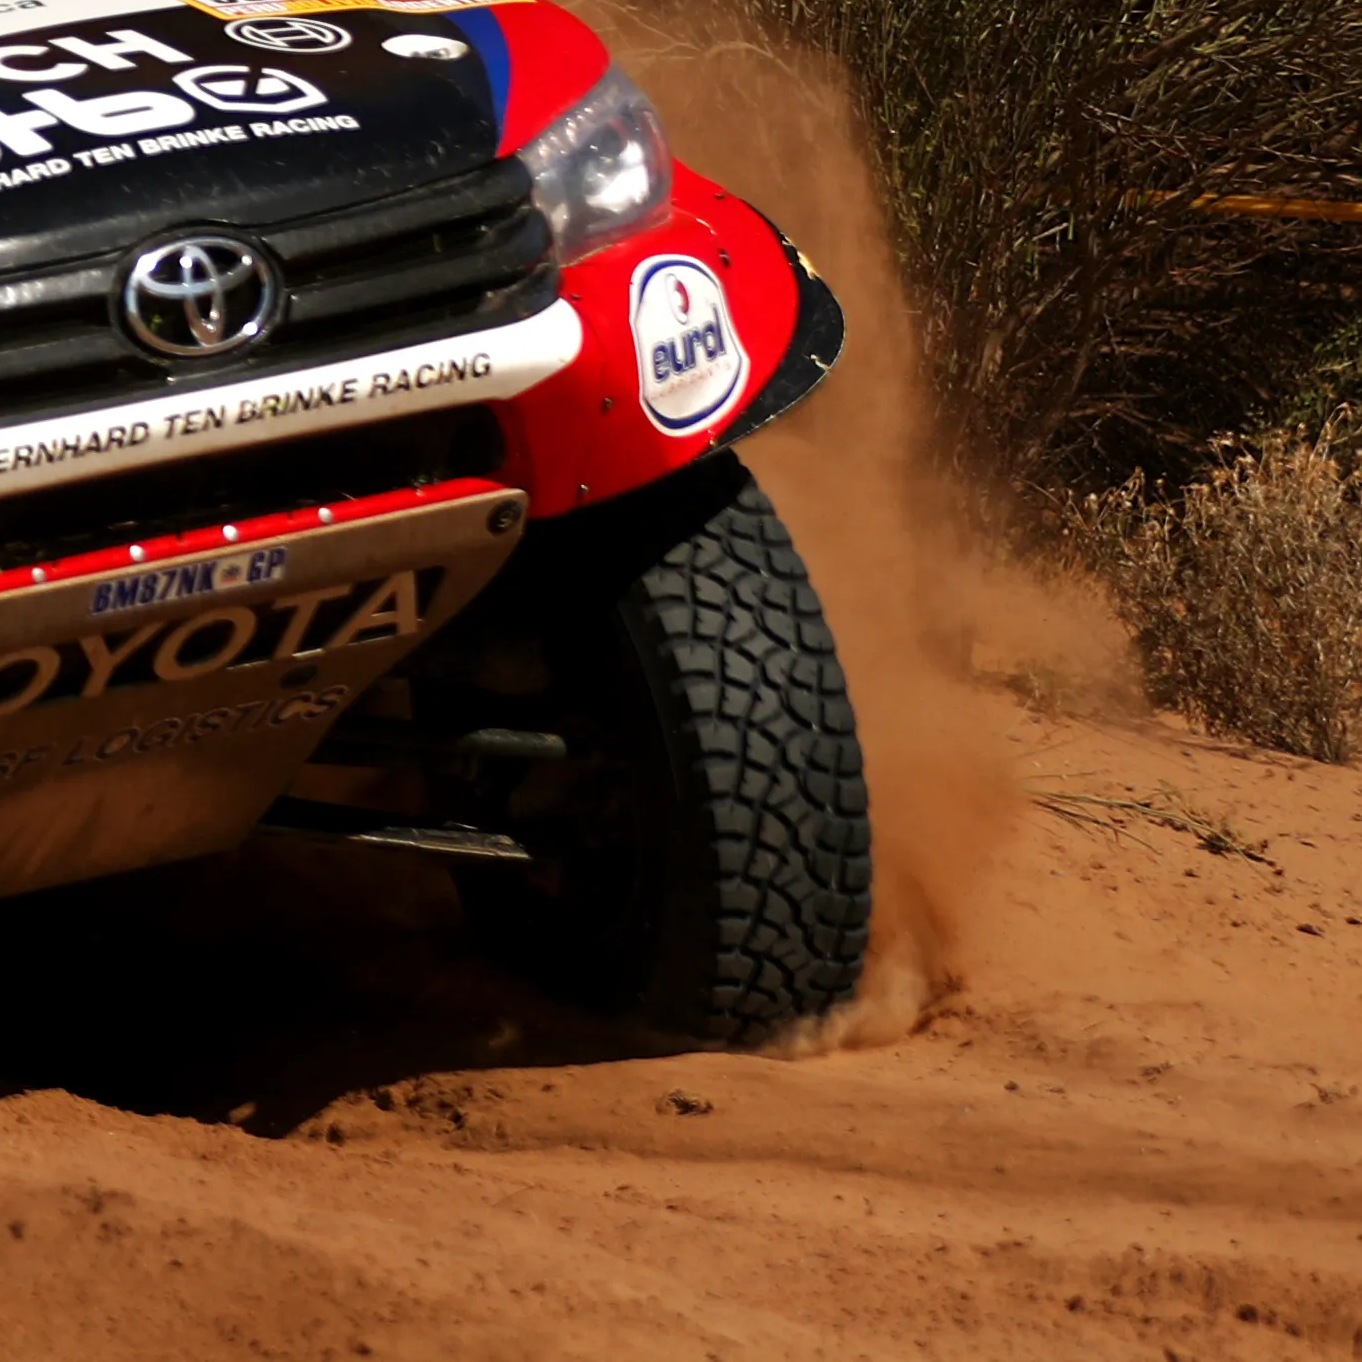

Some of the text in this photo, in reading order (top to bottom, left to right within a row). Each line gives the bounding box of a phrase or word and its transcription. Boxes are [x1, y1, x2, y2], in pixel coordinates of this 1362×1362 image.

[73, 145, 137, 170] TEN
[138, 124, 248, 156] BRINKE
[251, 114, 359, 138] RACING
[164, 405, 226, 441] TEN
[234, 378, 358, 425] BRINKE
[368, 352, 492, 400] RACING
[91, 546, 289, 615] BM87NK GP
[62, 684, 349, 766] LOGISTICS
